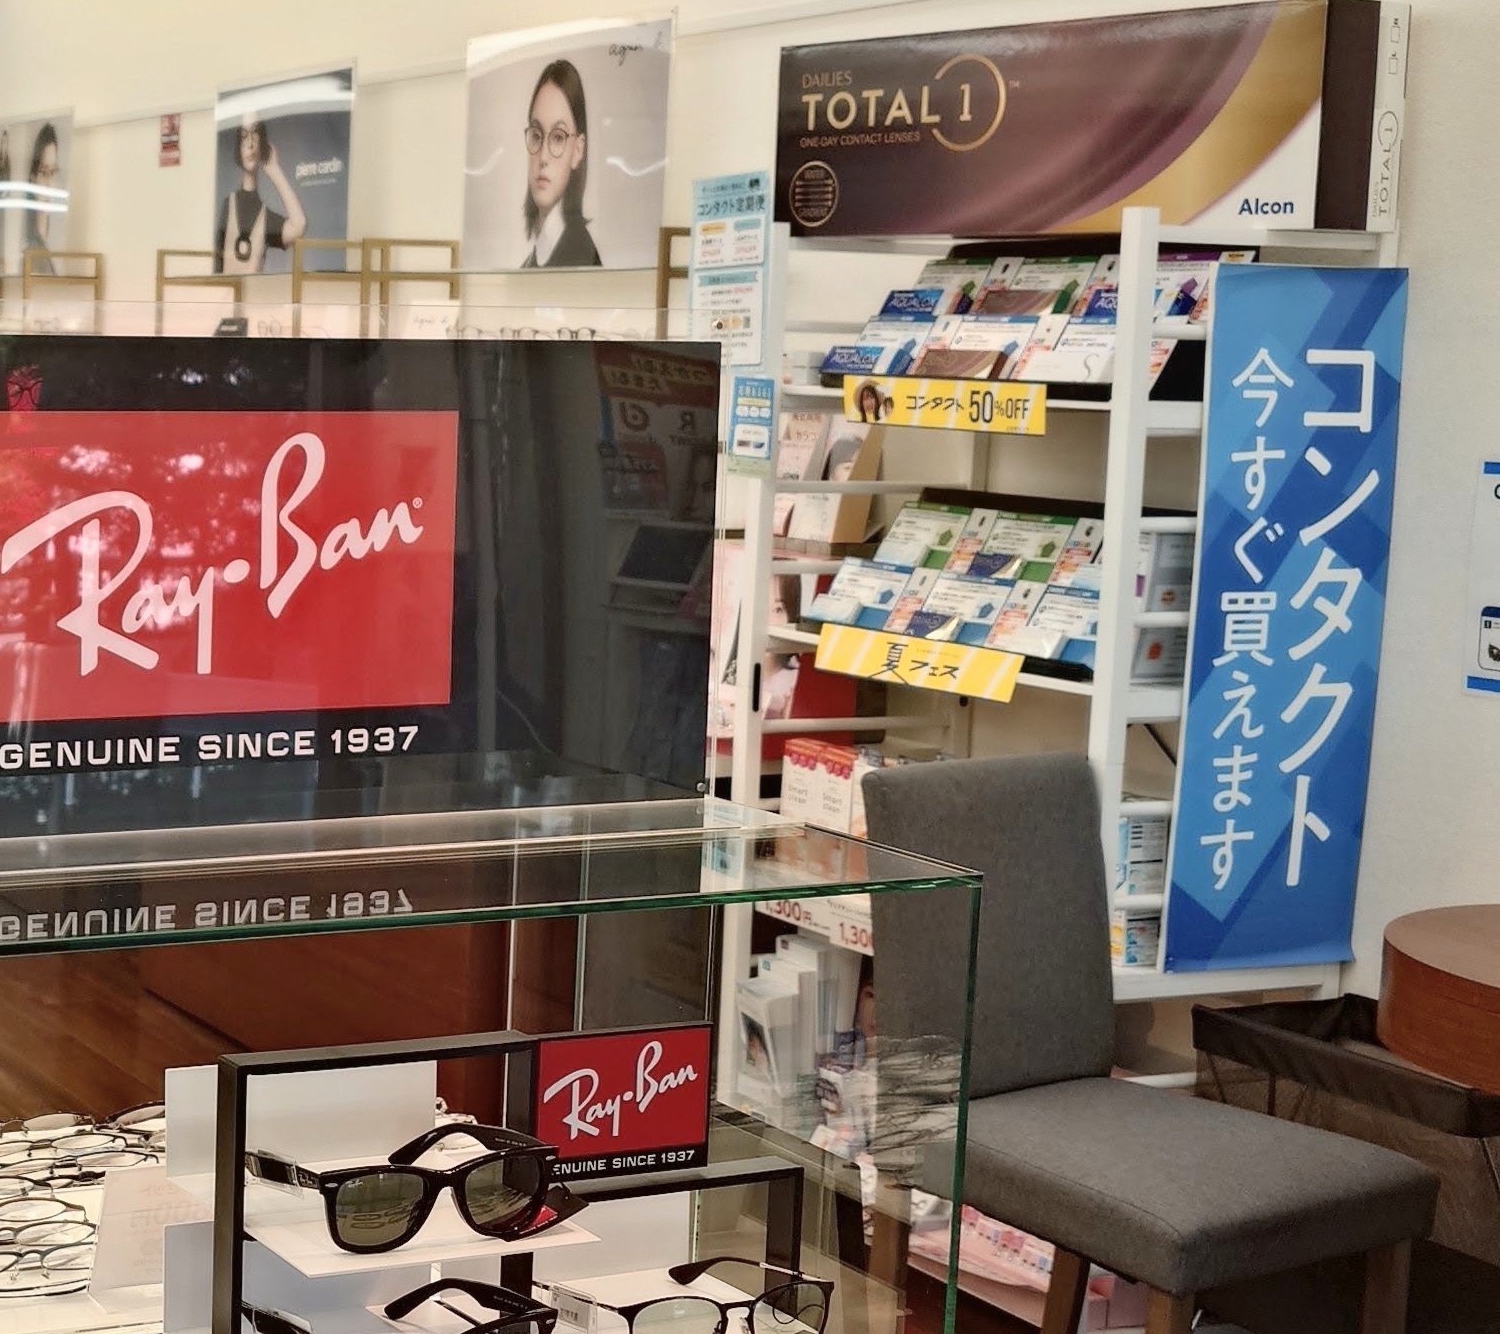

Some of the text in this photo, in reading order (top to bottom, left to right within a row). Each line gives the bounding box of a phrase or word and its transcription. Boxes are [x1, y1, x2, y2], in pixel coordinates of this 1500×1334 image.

[802, 71, 852, 88] DAILIES
[802, 85, 940, 131] TOTAL
[884, 131, 921, 144] LENSES
[1238, 198, 1295, 215] Alcon
[906, 389, 1031, 424] コンタクト 50%OFF
[0, 432, 424, 676] Ray-Ban
[1200, 347, 1294, 891] 今すぐ買えます
[1278, 348, 1379, 888] コンタクト
[0, 726, 419, 770] GENUINE SINCE 1937
[543, 1040, 699, 1140] Ray-Ban
[551, 1150, 695, 1176] ENUINE SINCE 1937
